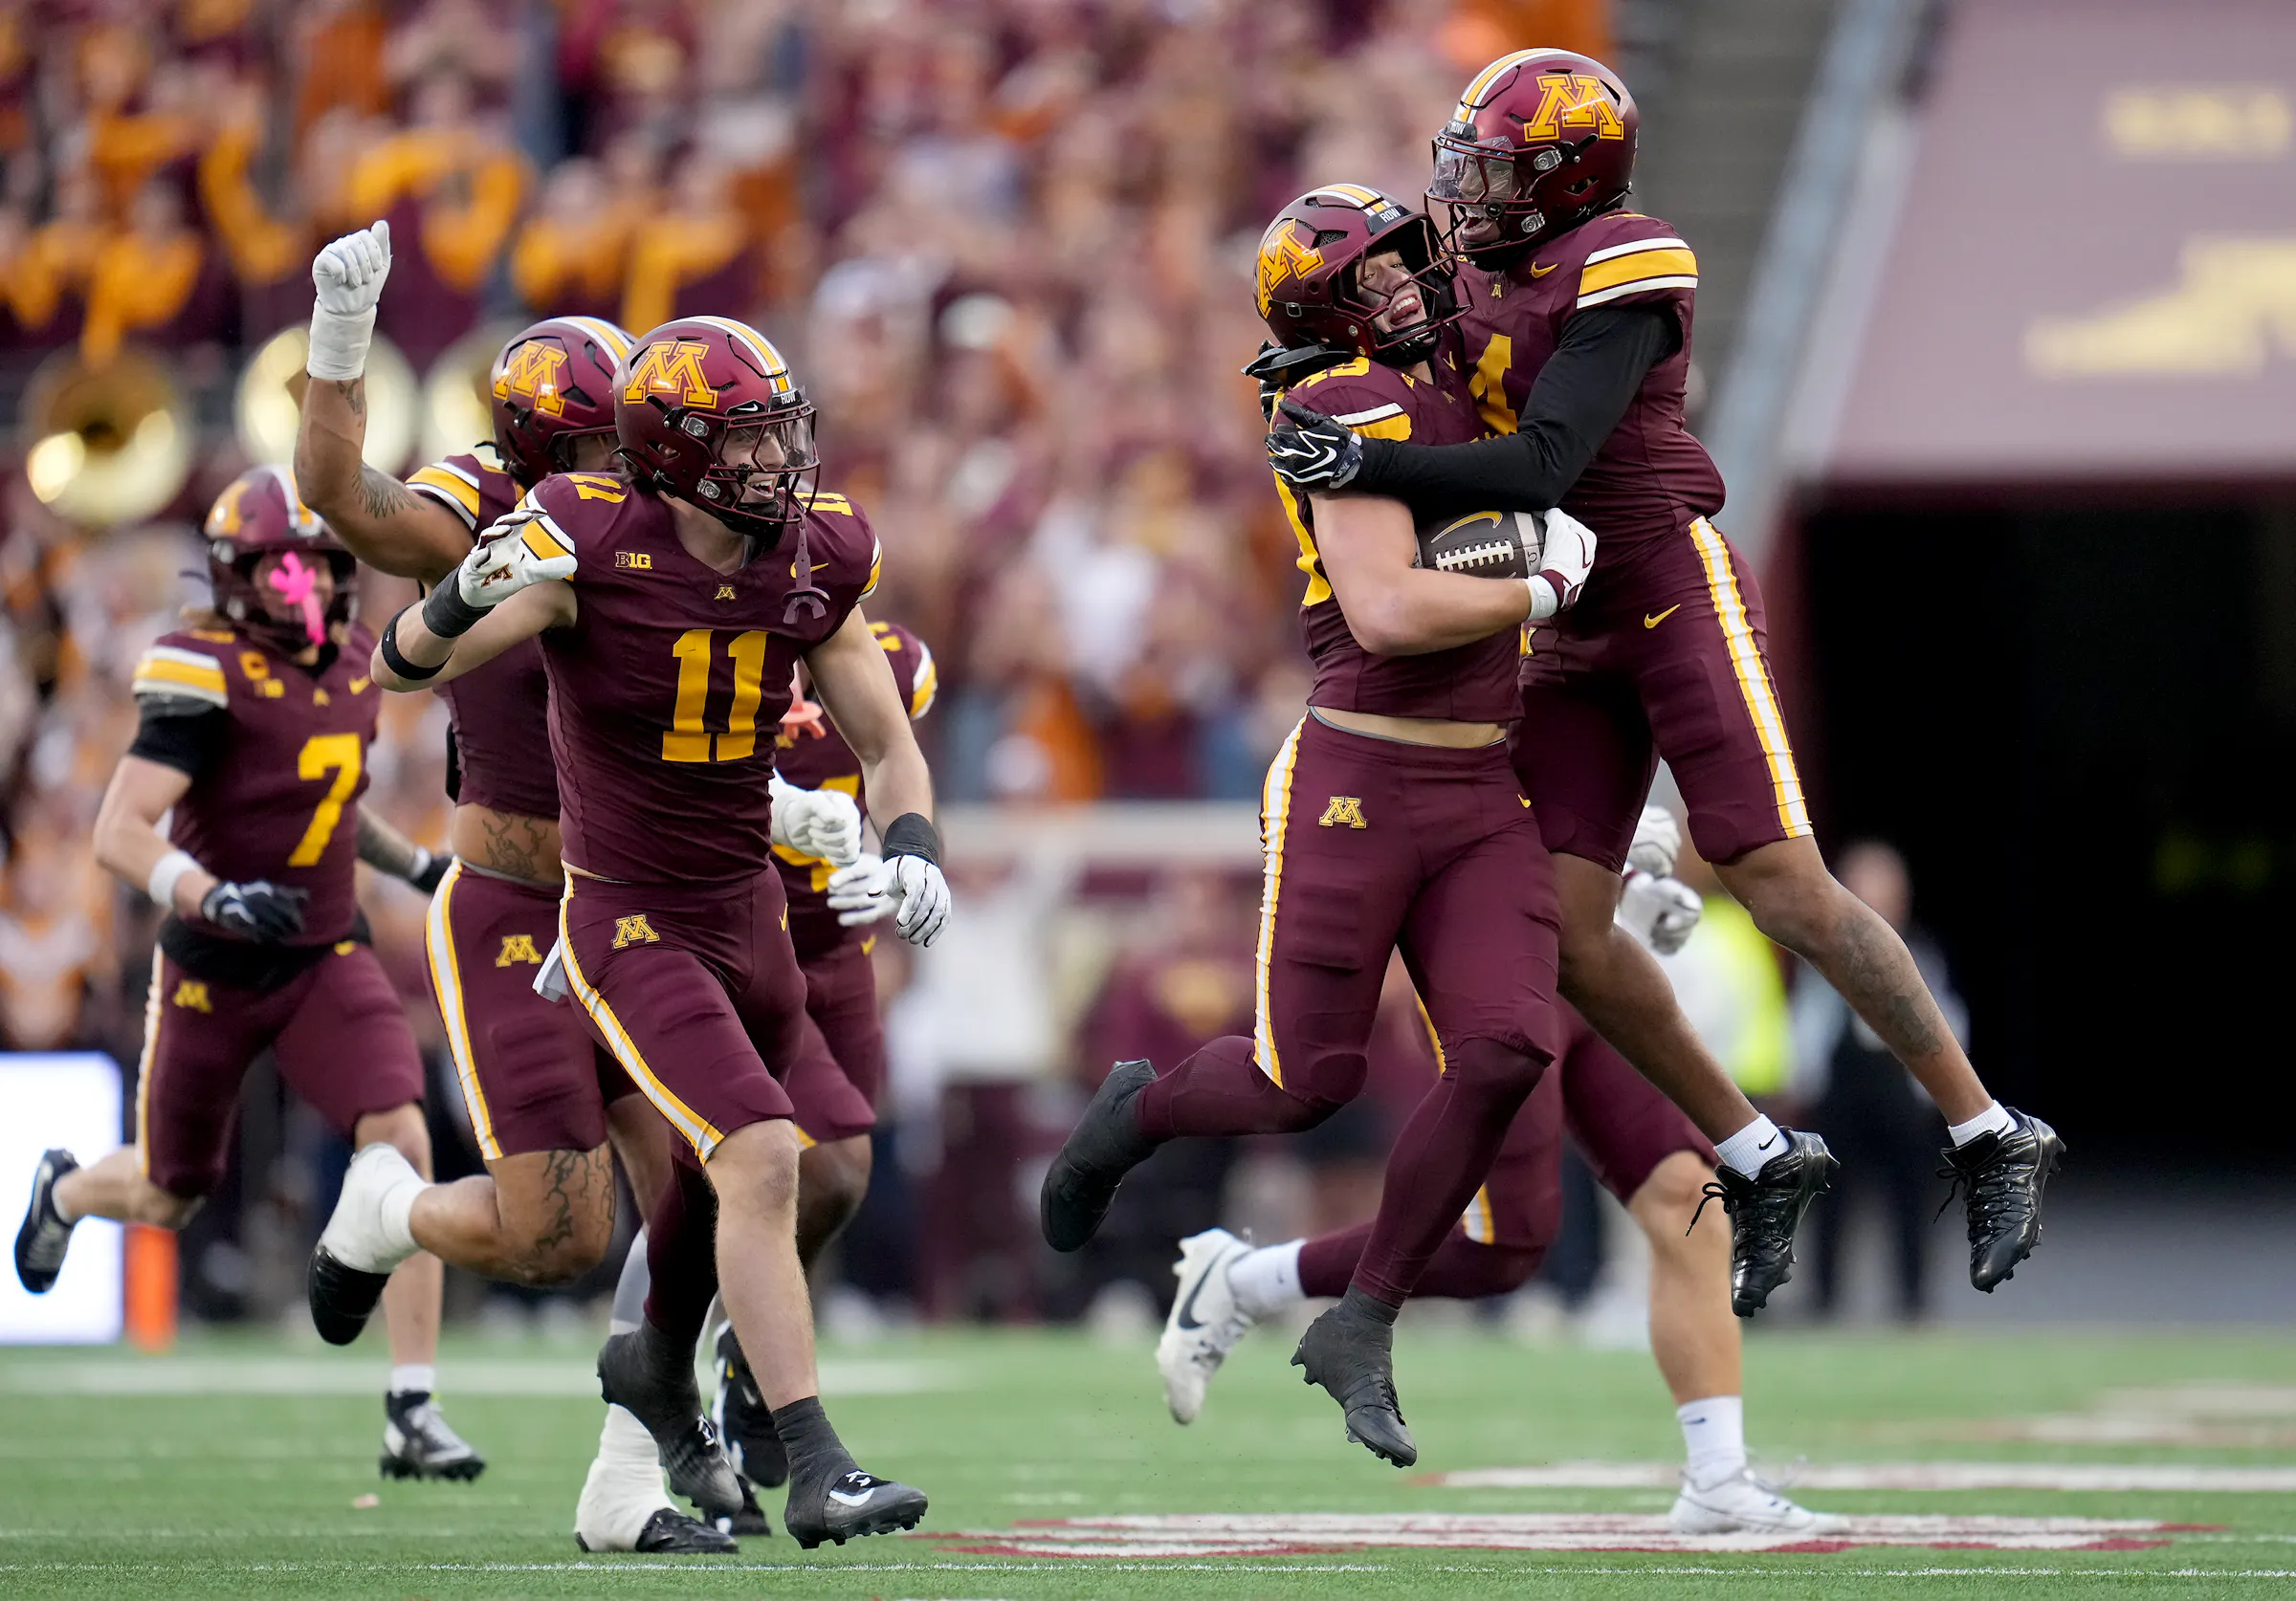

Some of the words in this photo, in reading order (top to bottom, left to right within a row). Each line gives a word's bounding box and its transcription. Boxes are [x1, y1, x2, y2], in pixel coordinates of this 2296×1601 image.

[1524, 74, 1624, 142] M
[1380, 208, 1401, 224] ROW
[1257, 218, 1325, 319] M
[493, 340, 568, 418] M
[624, 340, 718, 409] M
[781, 391, 796, 406] ROW
[714, 584, 737, 601] M
[661, 628, 770, 762] 11
[288, 732, 362, 867] 7
[1318, 796, 1368, 829] M
[495, 933, 543, 968] M
[611, 913, 660, 950] M
